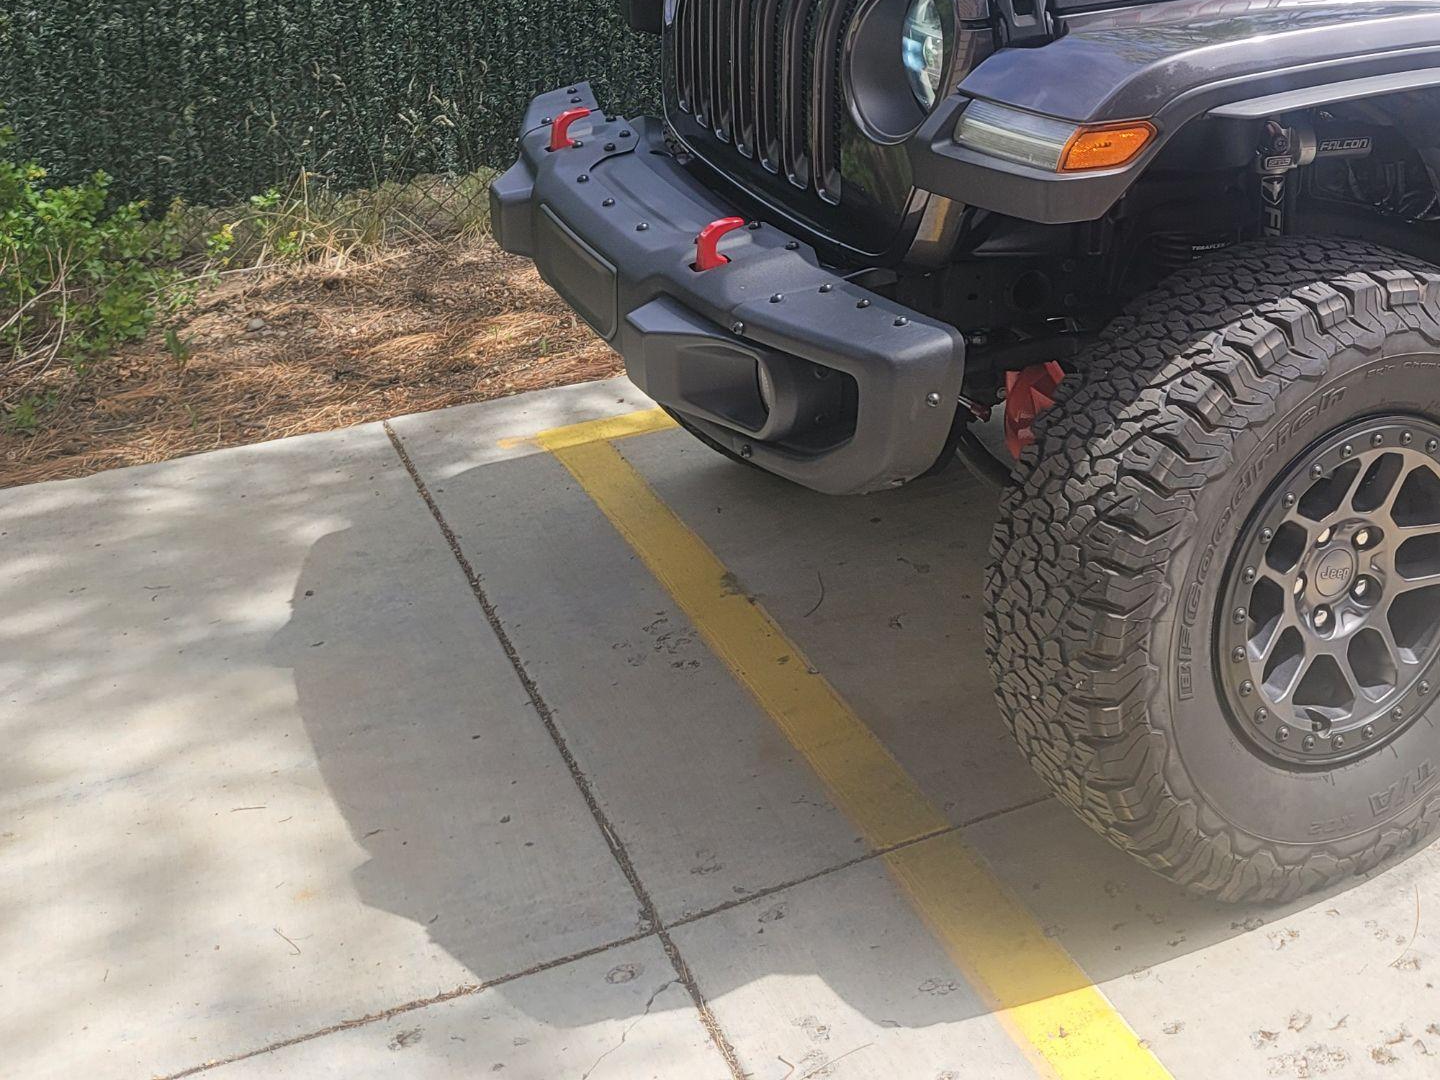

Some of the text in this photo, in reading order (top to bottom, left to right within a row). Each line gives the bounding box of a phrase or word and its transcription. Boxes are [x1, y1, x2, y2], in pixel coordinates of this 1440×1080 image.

[1319, 138, 1369, 151] FALCON
[1177, 386, 1348, 701] BFGoodrich
[1321, 565, 1350, 580] Jeep
